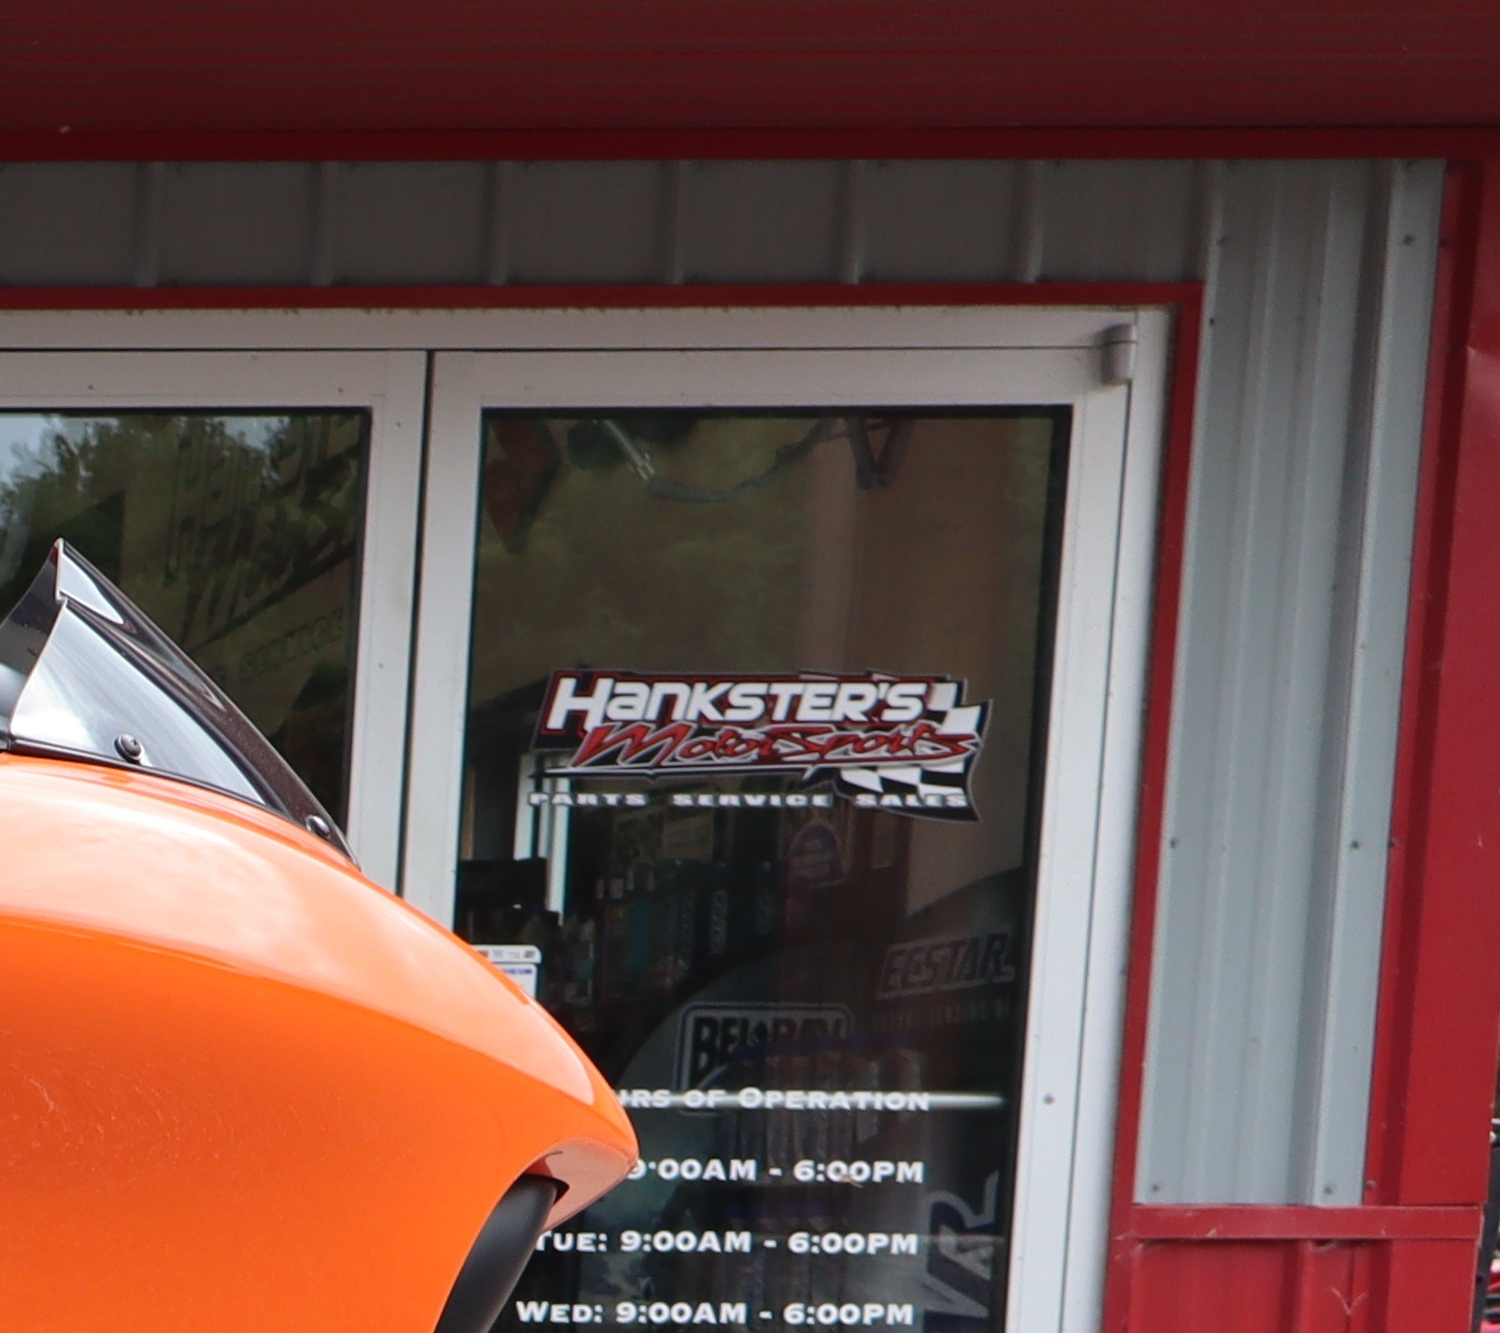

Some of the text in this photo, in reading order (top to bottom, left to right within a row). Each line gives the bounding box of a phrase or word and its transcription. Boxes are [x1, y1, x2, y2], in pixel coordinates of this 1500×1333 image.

[529, 793, 970, 807] PARTS SERVICE SALES
[792, 1159, 925, 1184] 6:00PM
[619, 1230, 753, 1254] 9:00AM
[787, 1231, 919, 1255] 6:00PM
[615, 1301, 748, 1325] 9:00AM
[783, 1303, 914, 1326] 6:00PM
